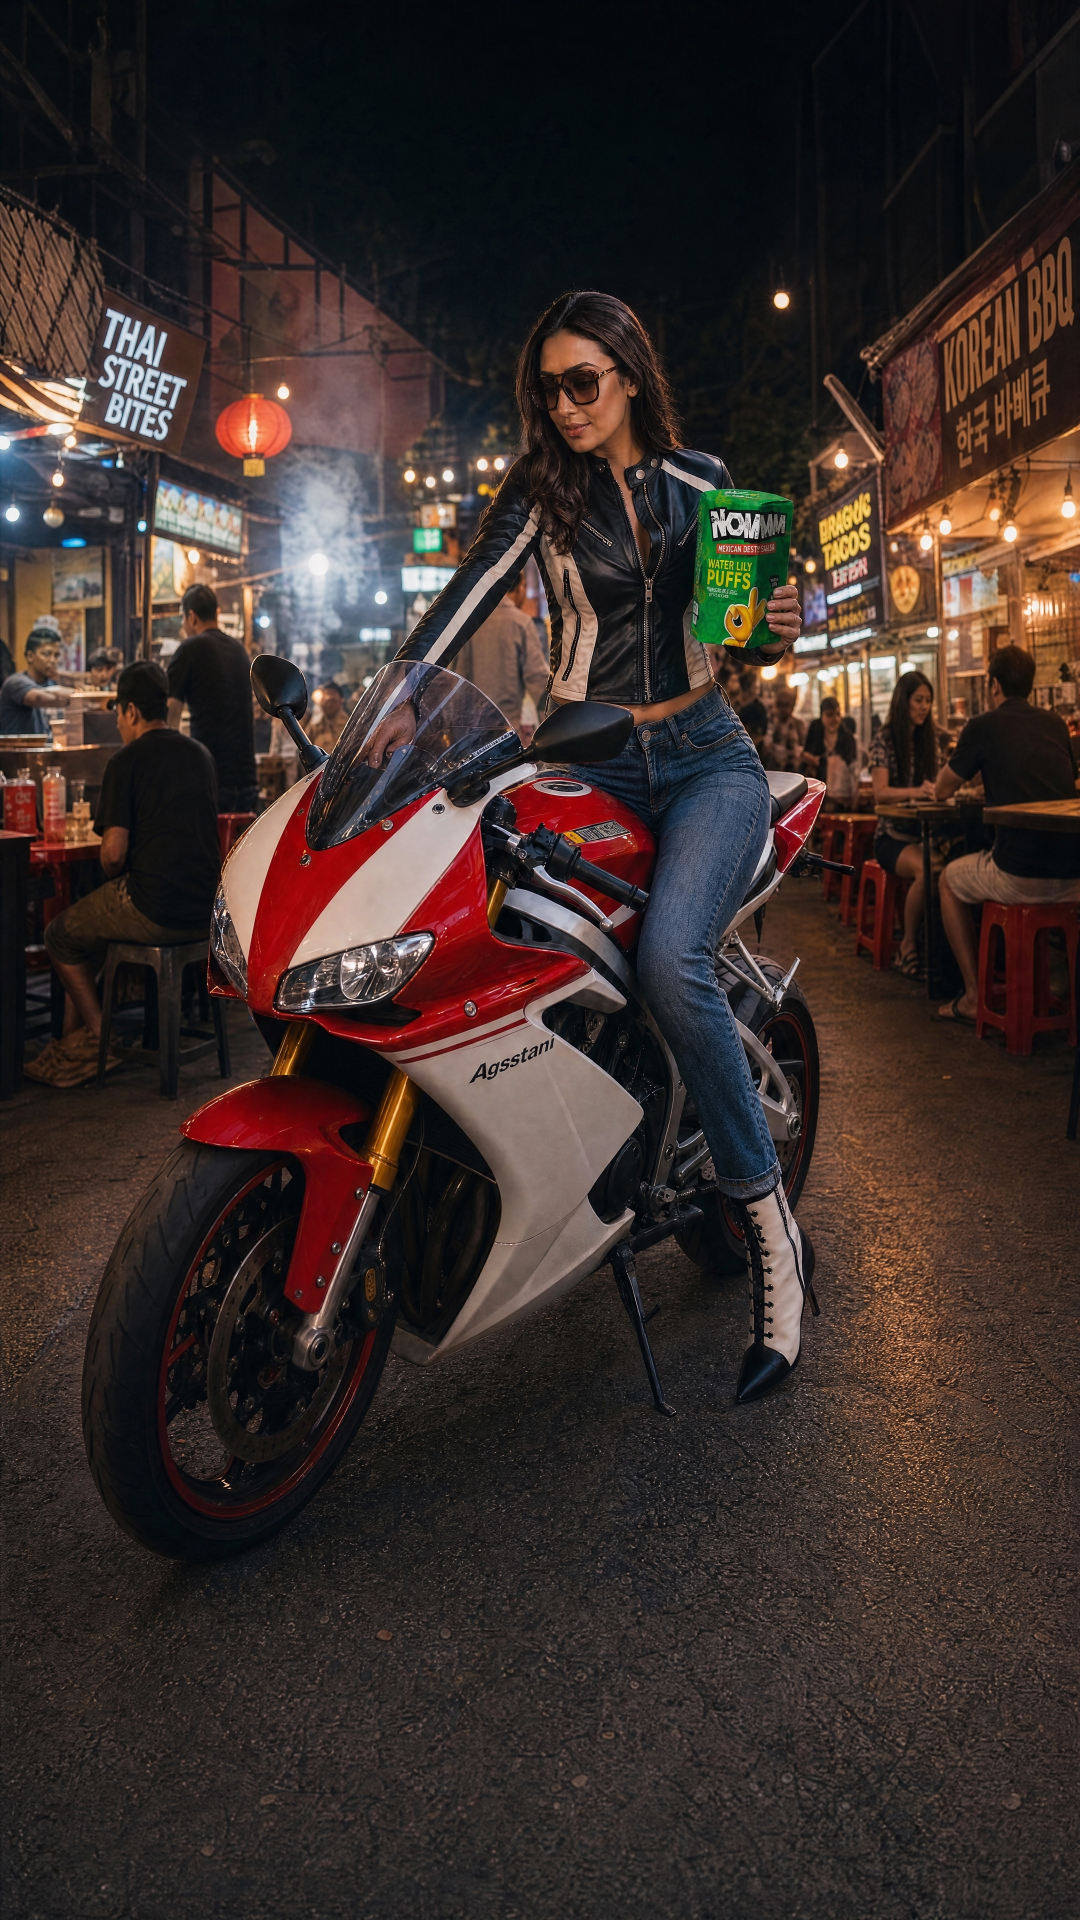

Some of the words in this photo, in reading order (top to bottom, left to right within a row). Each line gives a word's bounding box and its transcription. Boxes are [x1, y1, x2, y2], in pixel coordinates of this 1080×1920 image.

[103, 308, 168, 368] THAI
[943, 280, 1021, 413] KOREAN
[1027, 236, 1075, 354] BBQ
[98, 354, 188, 410] STREET
[104, 392, 173, 441] BITES
[956, 399, 990, 469] 한국
[994, 358, 1050, 440] 바베큐
[708, 559, 734, 570] WATER
[736, 561, 752, 571] LILY
[717, 544, 742, 553] MEXICAN
[822, 522, 872, 571] TACOS
[707, 569, 751, 590] PUFFS
[469, 1034, 555, 1084] Agsstani
